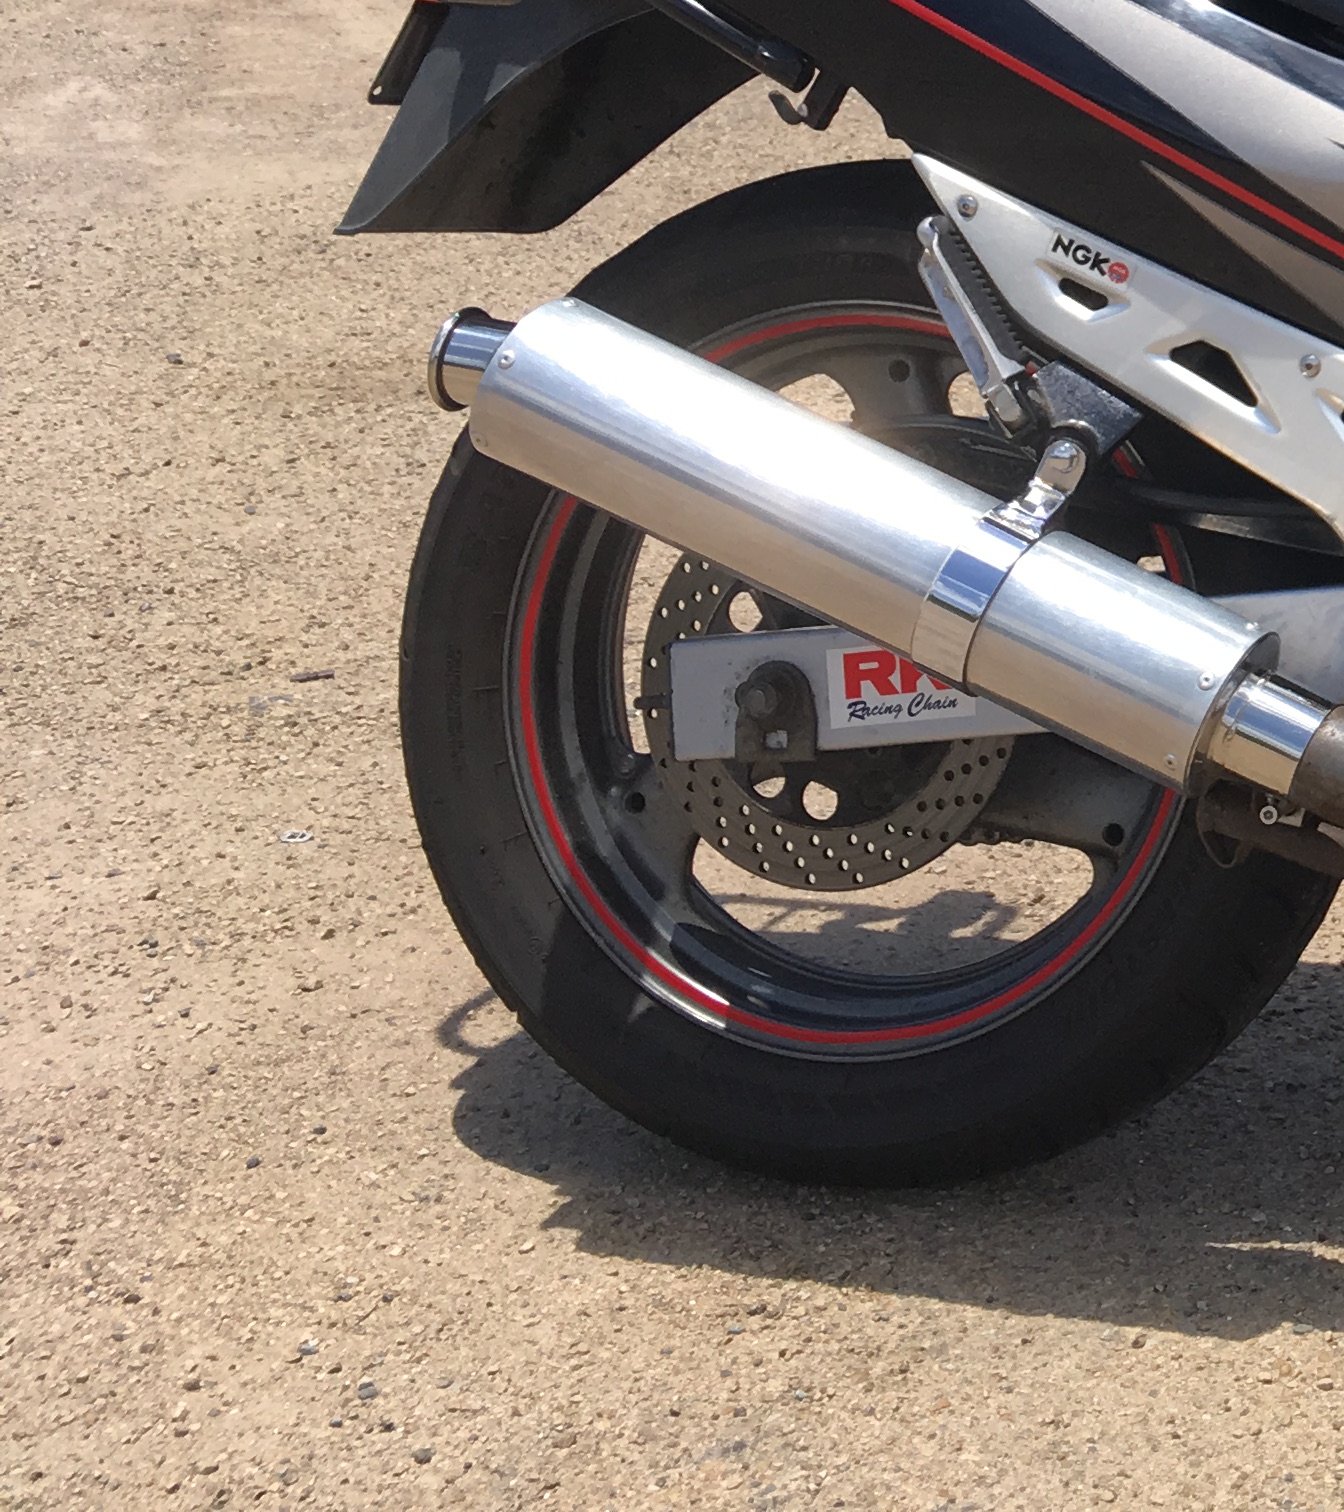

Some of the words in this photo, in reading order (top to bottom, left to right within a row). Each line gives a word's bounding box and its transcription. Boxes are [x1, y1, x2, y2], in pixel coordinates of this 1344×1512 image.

[1051, 234, 1110, 276] NGK
[847, 700, 903, 722] Racing
[908, 692, 958, 717] Chain
